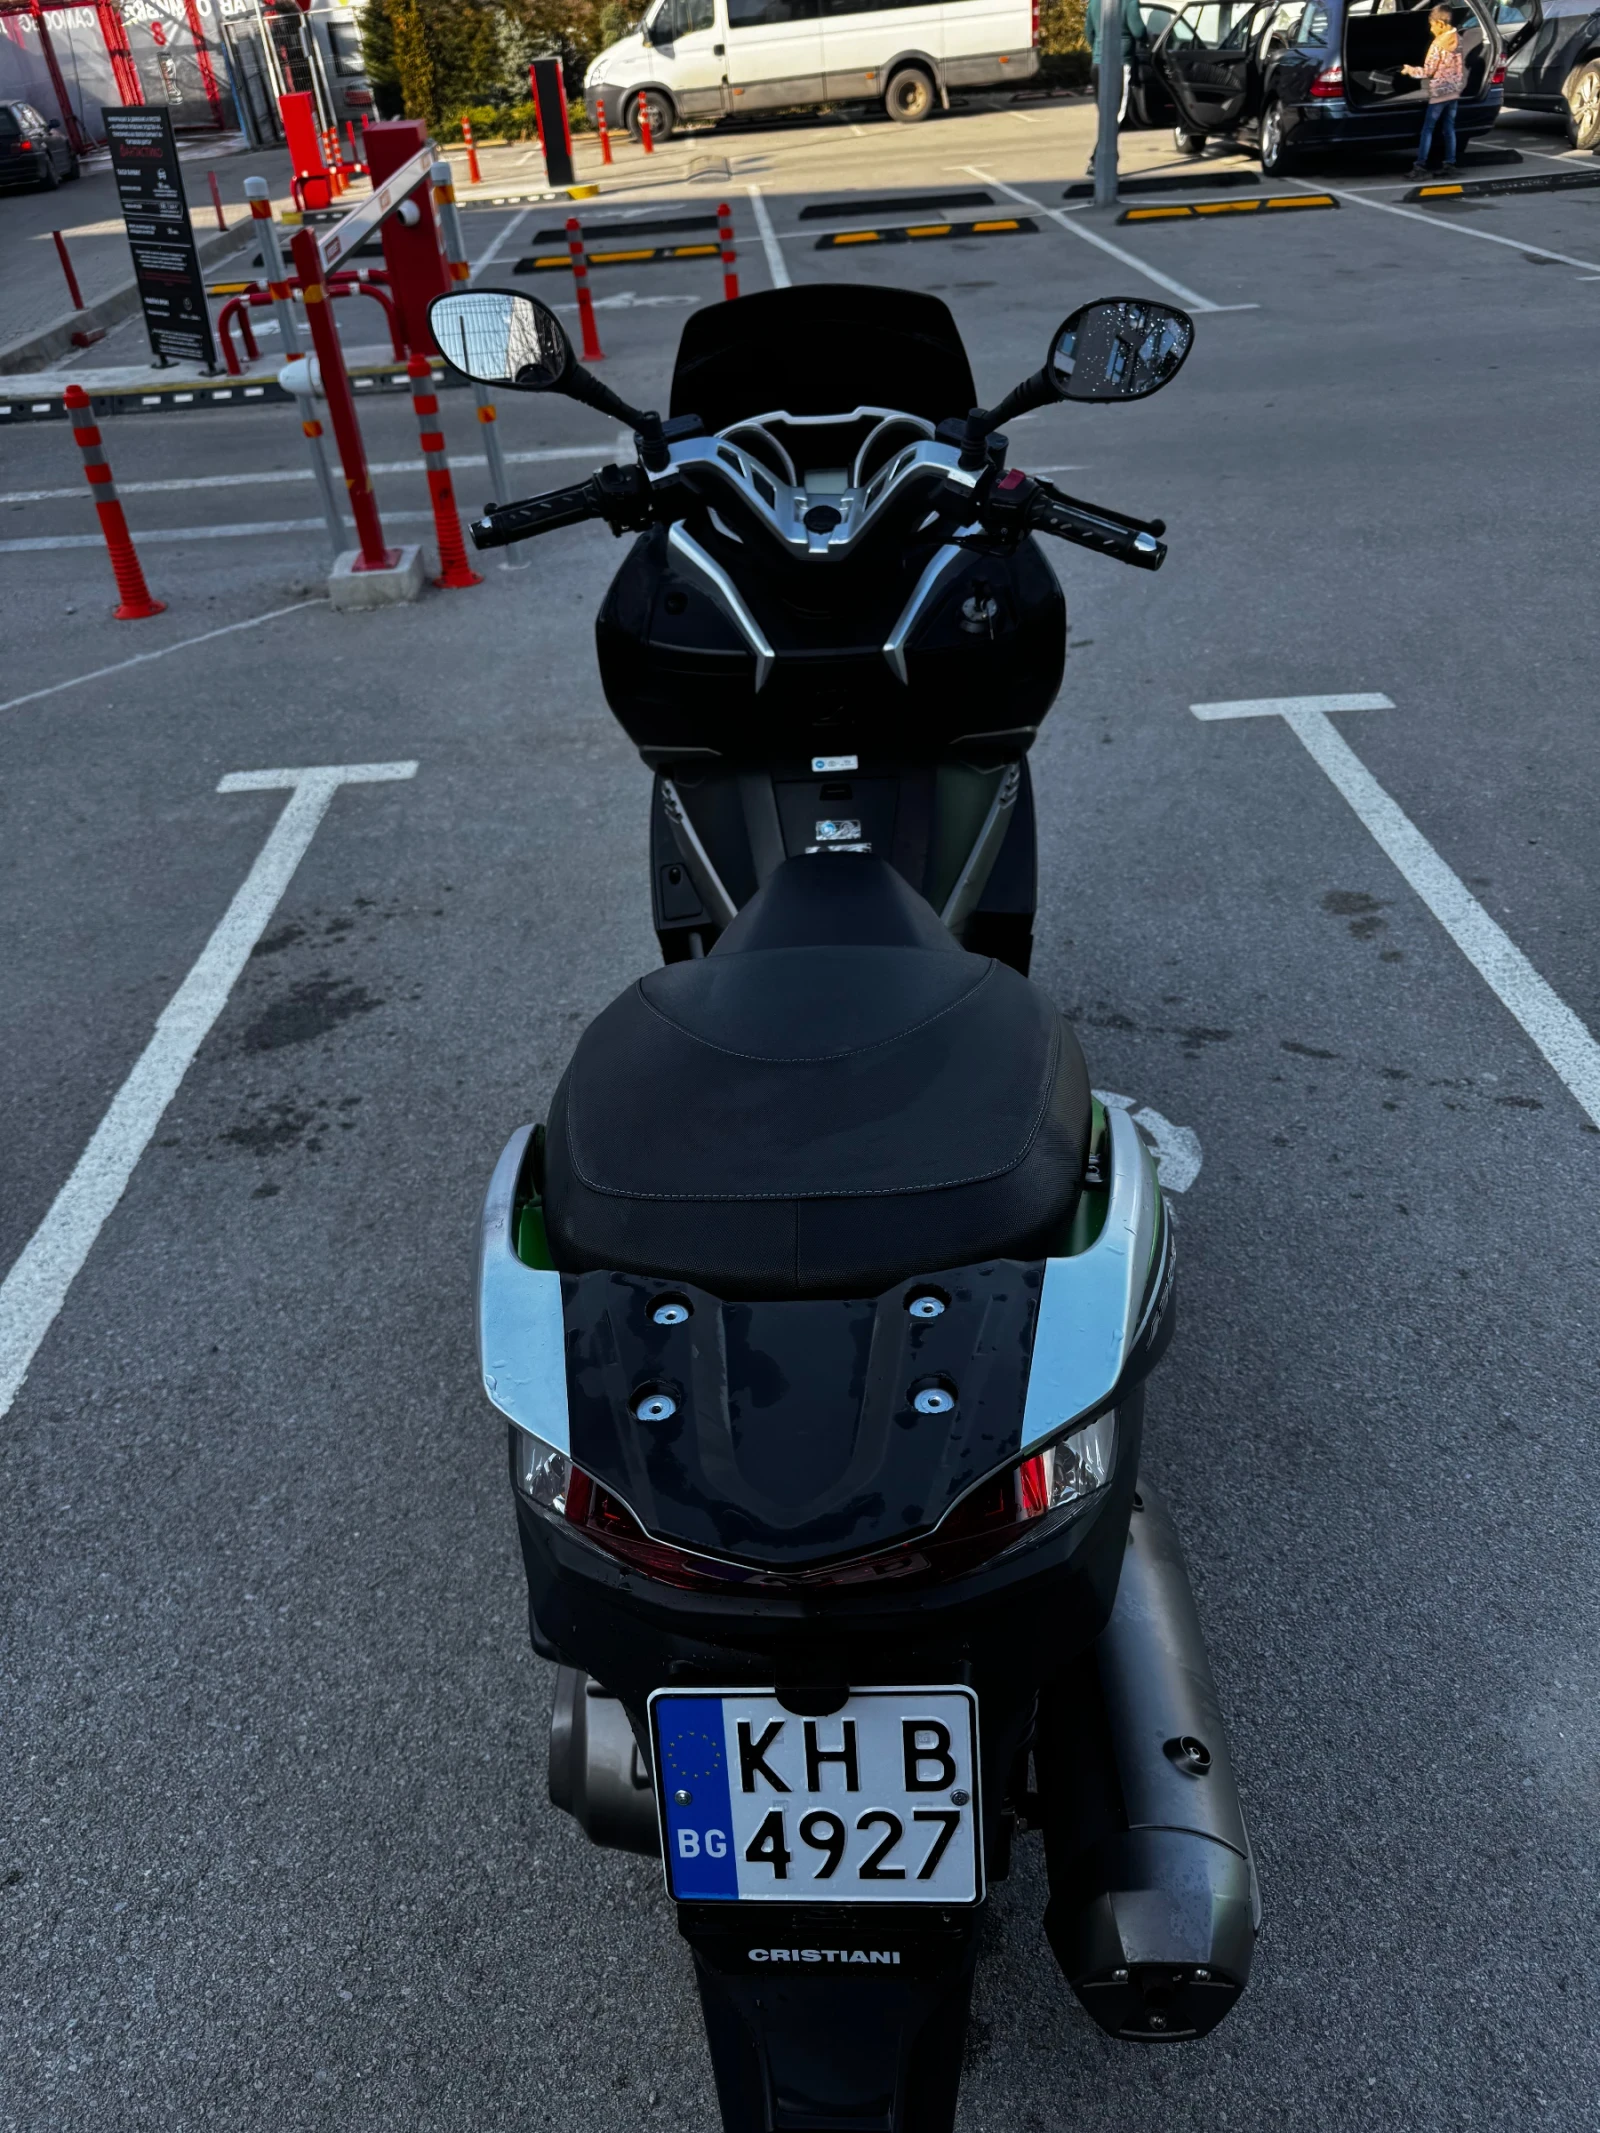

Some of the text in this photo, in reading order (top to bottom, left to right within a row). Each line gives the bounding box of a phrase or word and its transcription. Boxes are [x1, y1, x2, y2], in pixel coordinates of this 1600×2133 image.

[736, 1719, 957, 1793] KH B
[677, 1828, 728, 1859] BG
[745, 1809, 962, 1880] 4927
[748, 1947, 901, 1965] CRISTIANI
